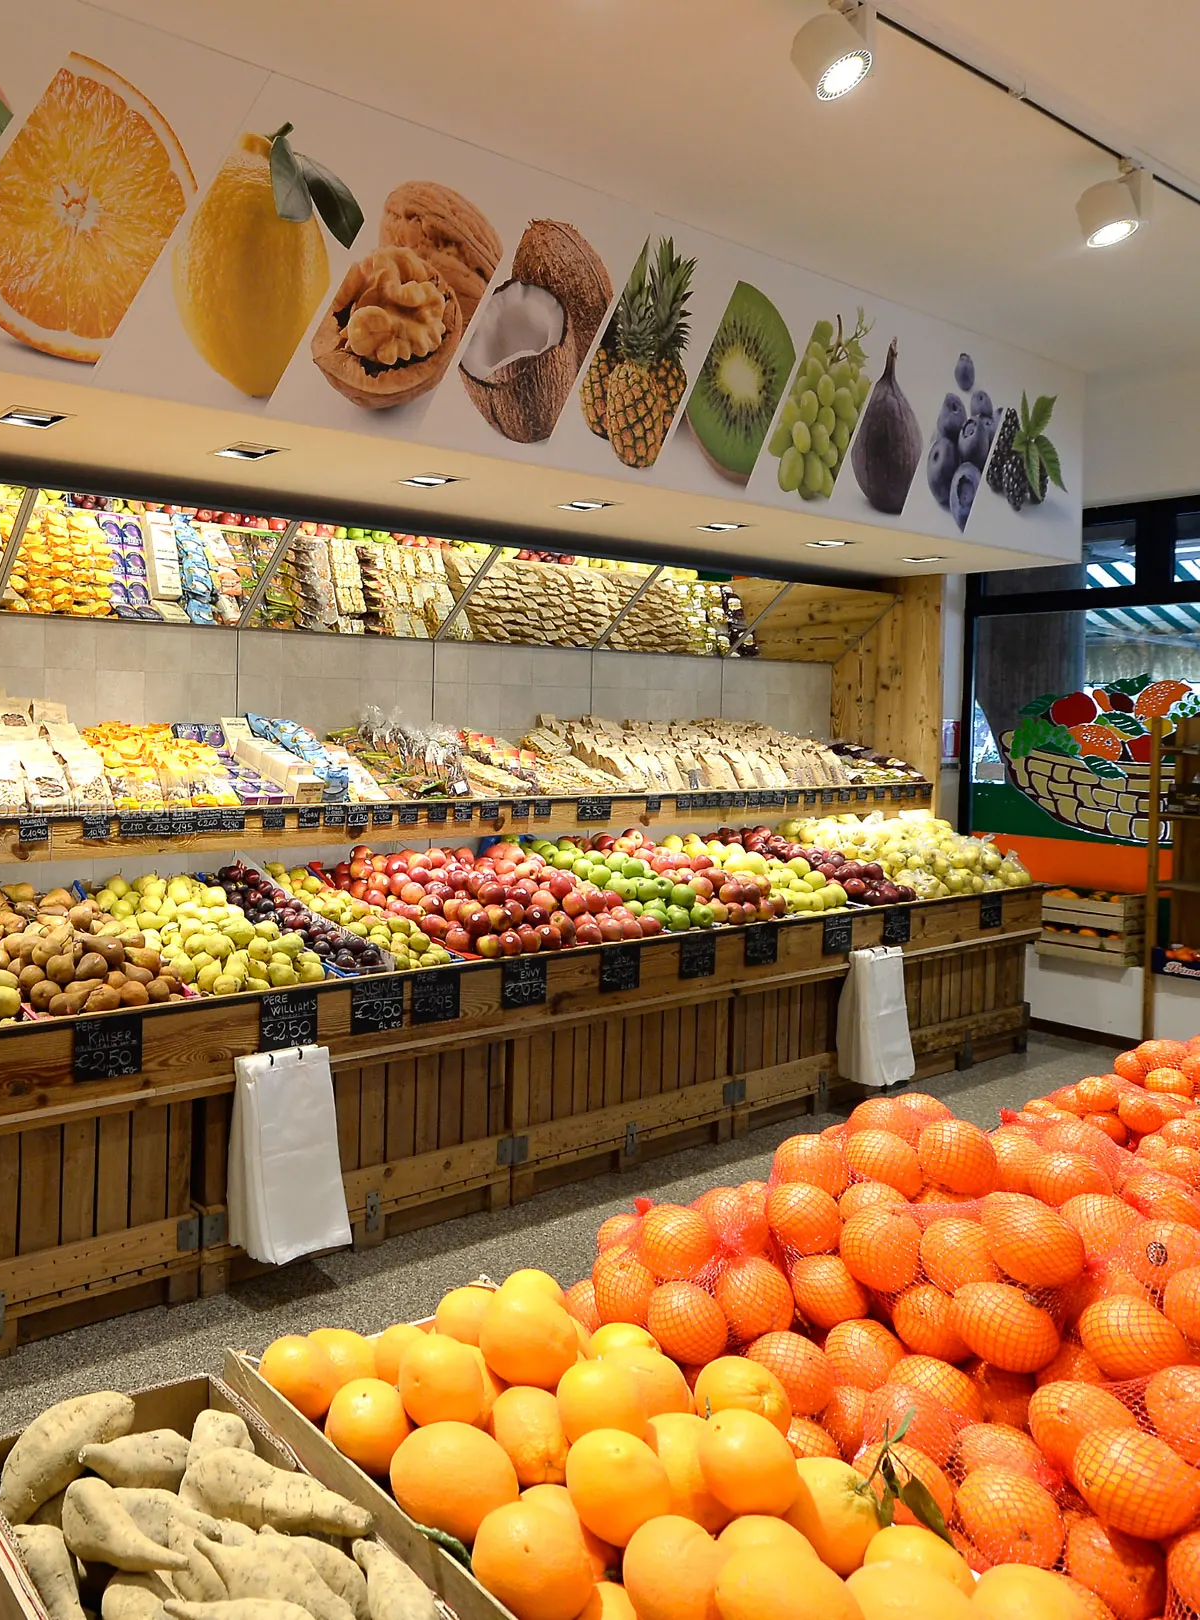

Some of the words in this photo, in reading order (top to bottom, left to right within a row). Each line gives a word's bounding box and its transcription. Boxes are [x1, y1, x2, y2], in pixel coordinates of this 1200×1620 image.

[520, 968, 540, 979] ENVY
[356, 978, 400, 996] SUSINE
[263, 994, 288, 1005] PERE
[271, 1000, 317, 1017] WILLIAMS
[75, 1021, 100, 1032] PERE
[88, 1030, 132, 1048] KAISER
